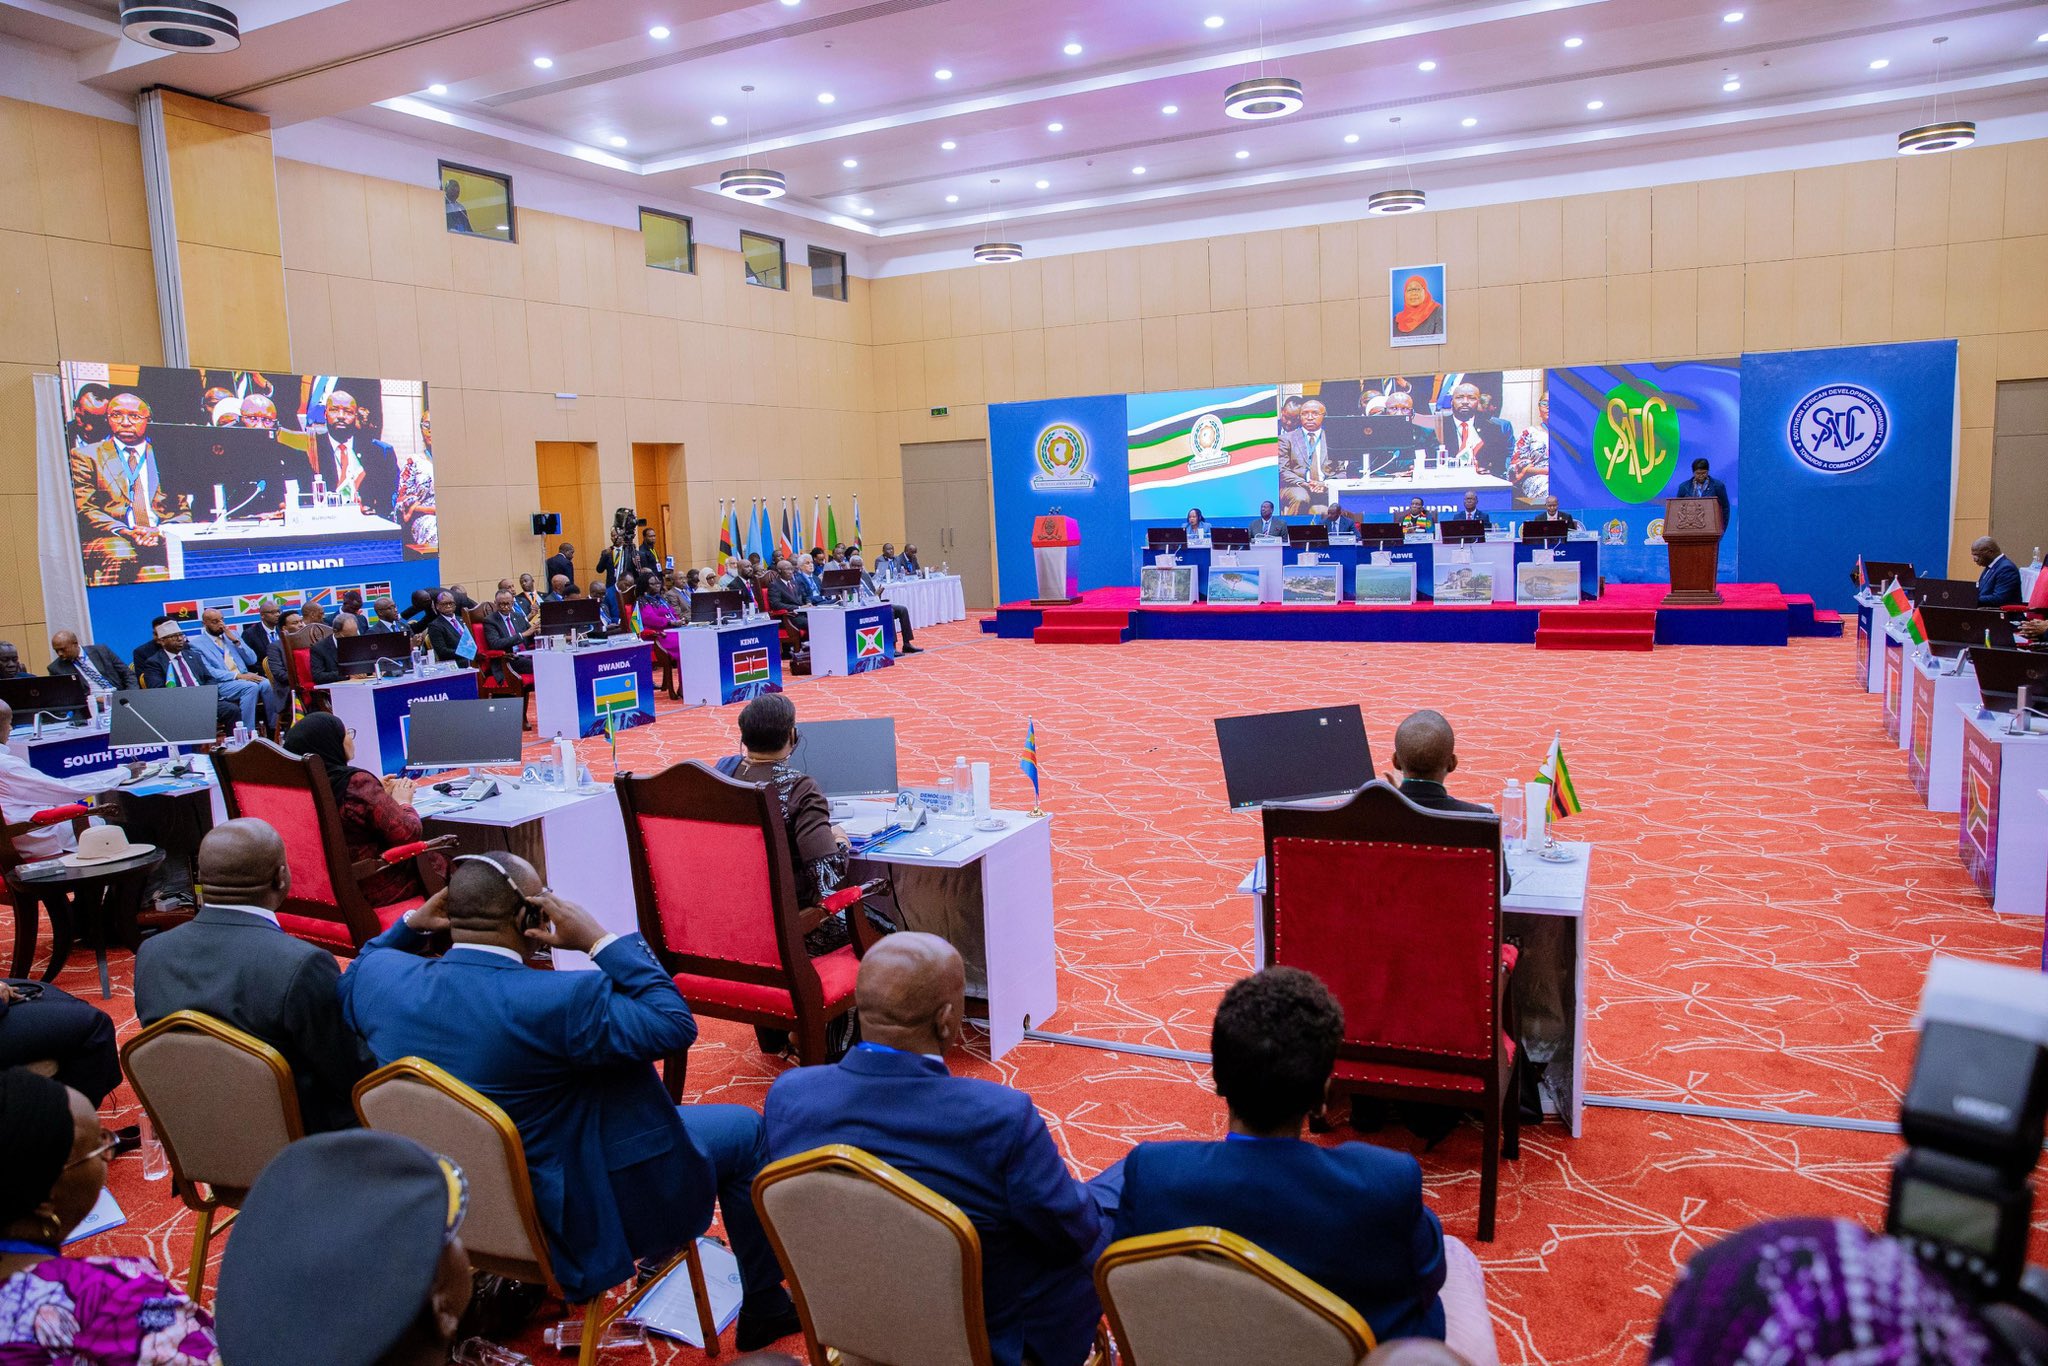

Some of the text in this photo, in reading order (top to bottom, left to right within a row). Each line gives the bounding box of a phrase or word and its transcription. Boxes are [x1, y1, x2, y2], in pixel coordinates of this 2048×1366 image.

[1792, 388, 1885, 441] SOUTHERN AFRICAN DEVELOPMENT COMMUNITY
[1800, 448, 1822, 467] TOWARDS
[1828, 460, 1857, 469] COMMON
[1856, 445, 1877, 463] FUTURE
[1389, 505, 1458, 514] BUNDI
[739, 637, 760, 646] KENYA
[597, 660, 631, 672] RWANDA
[63, 746, 163, 769] SOUTH SUDAN
